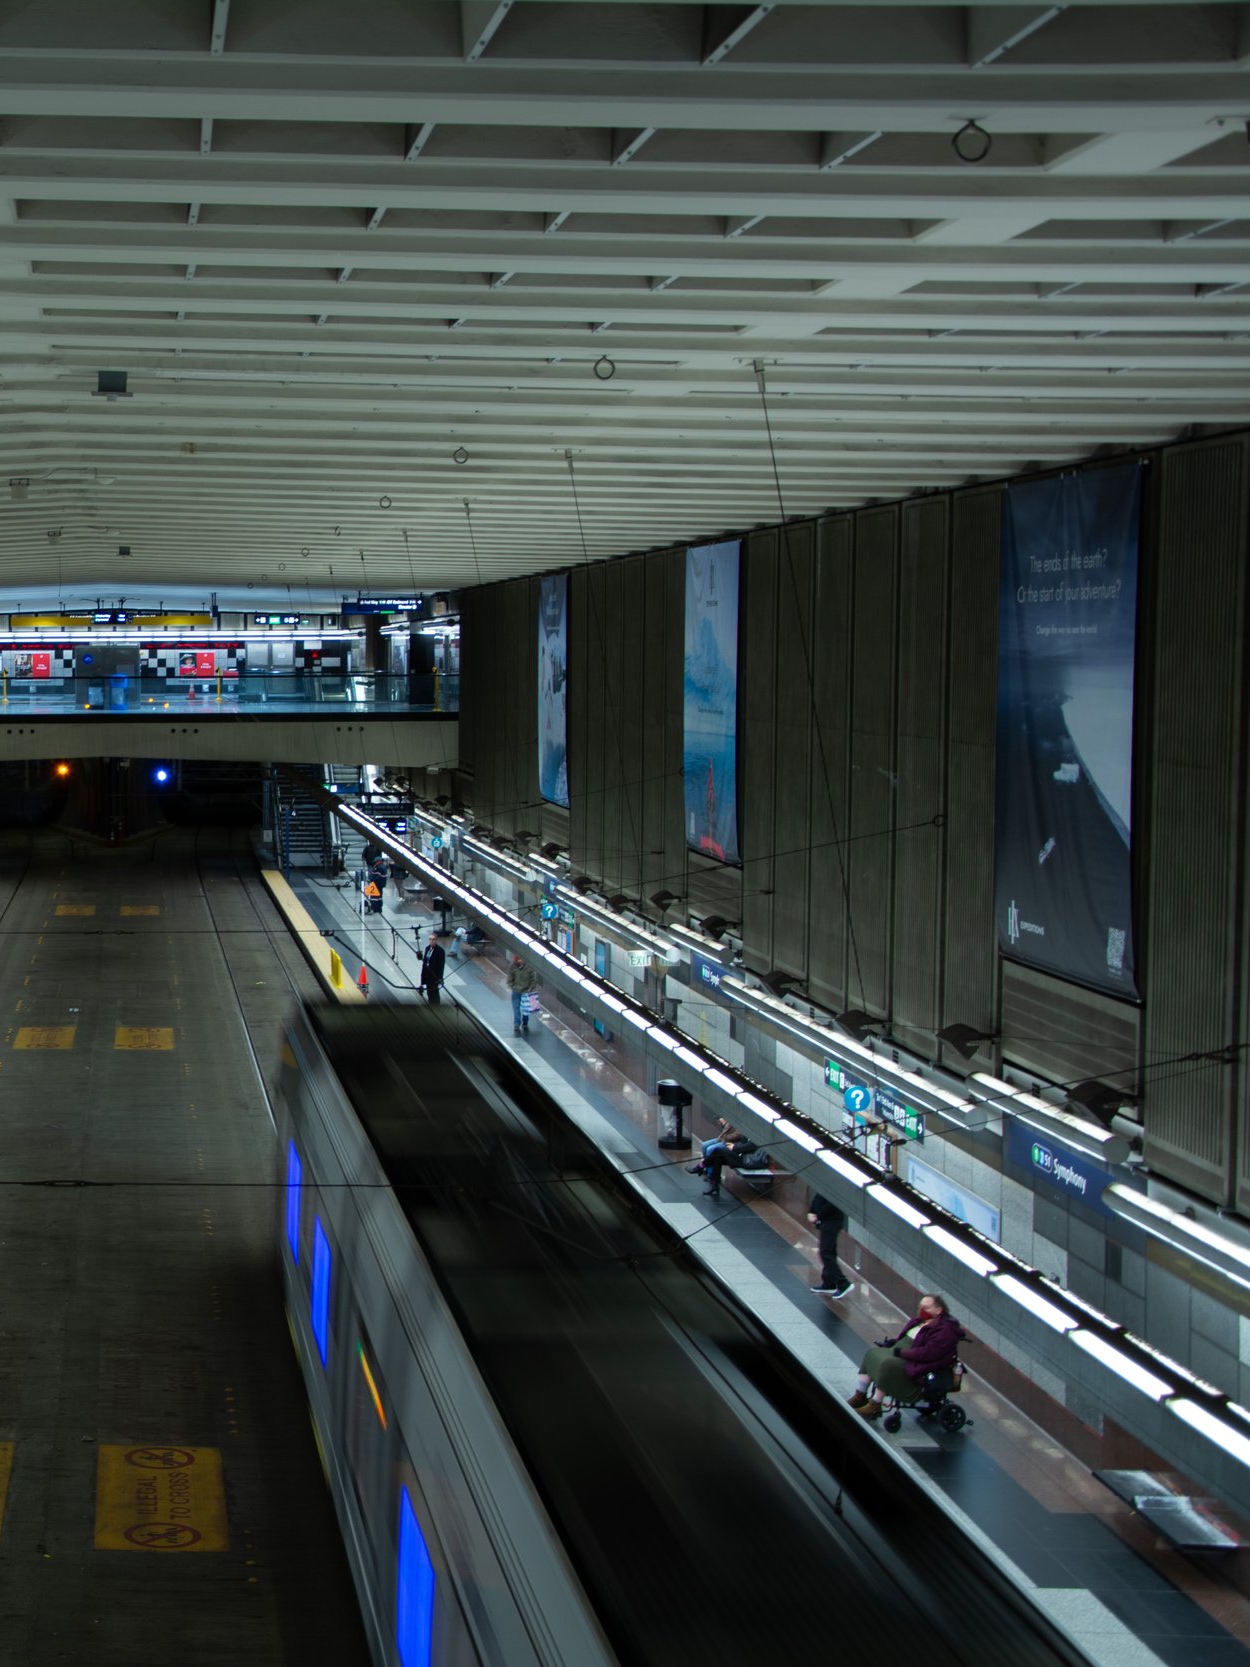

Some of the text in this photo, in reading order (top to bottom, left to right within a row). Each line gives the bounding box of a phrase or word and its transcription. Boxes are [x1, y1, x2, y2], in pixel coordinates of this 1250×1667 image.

[1030, 555, 1042, 573] The
[1044, 552, 1061, 572] ends
[1070, 550, 1082, 570] the
[1083, 548, 1108, 569] earth?
[1017, 586, 1027, 603] Or
[1027, 584, 1038, 602] the
[1040, 586, 1054, 602] start
[1056, 581, 1064, 601] of
[1080, 580, 1122, 600] adventure?
[631, 955, 650, 965] EXIT
[1054, 1158, 1086, 1194] Symphony
[136, 1476, 158, 1516] ILLEGAL
[168, 1472, 191, 1519] TO CROSS
